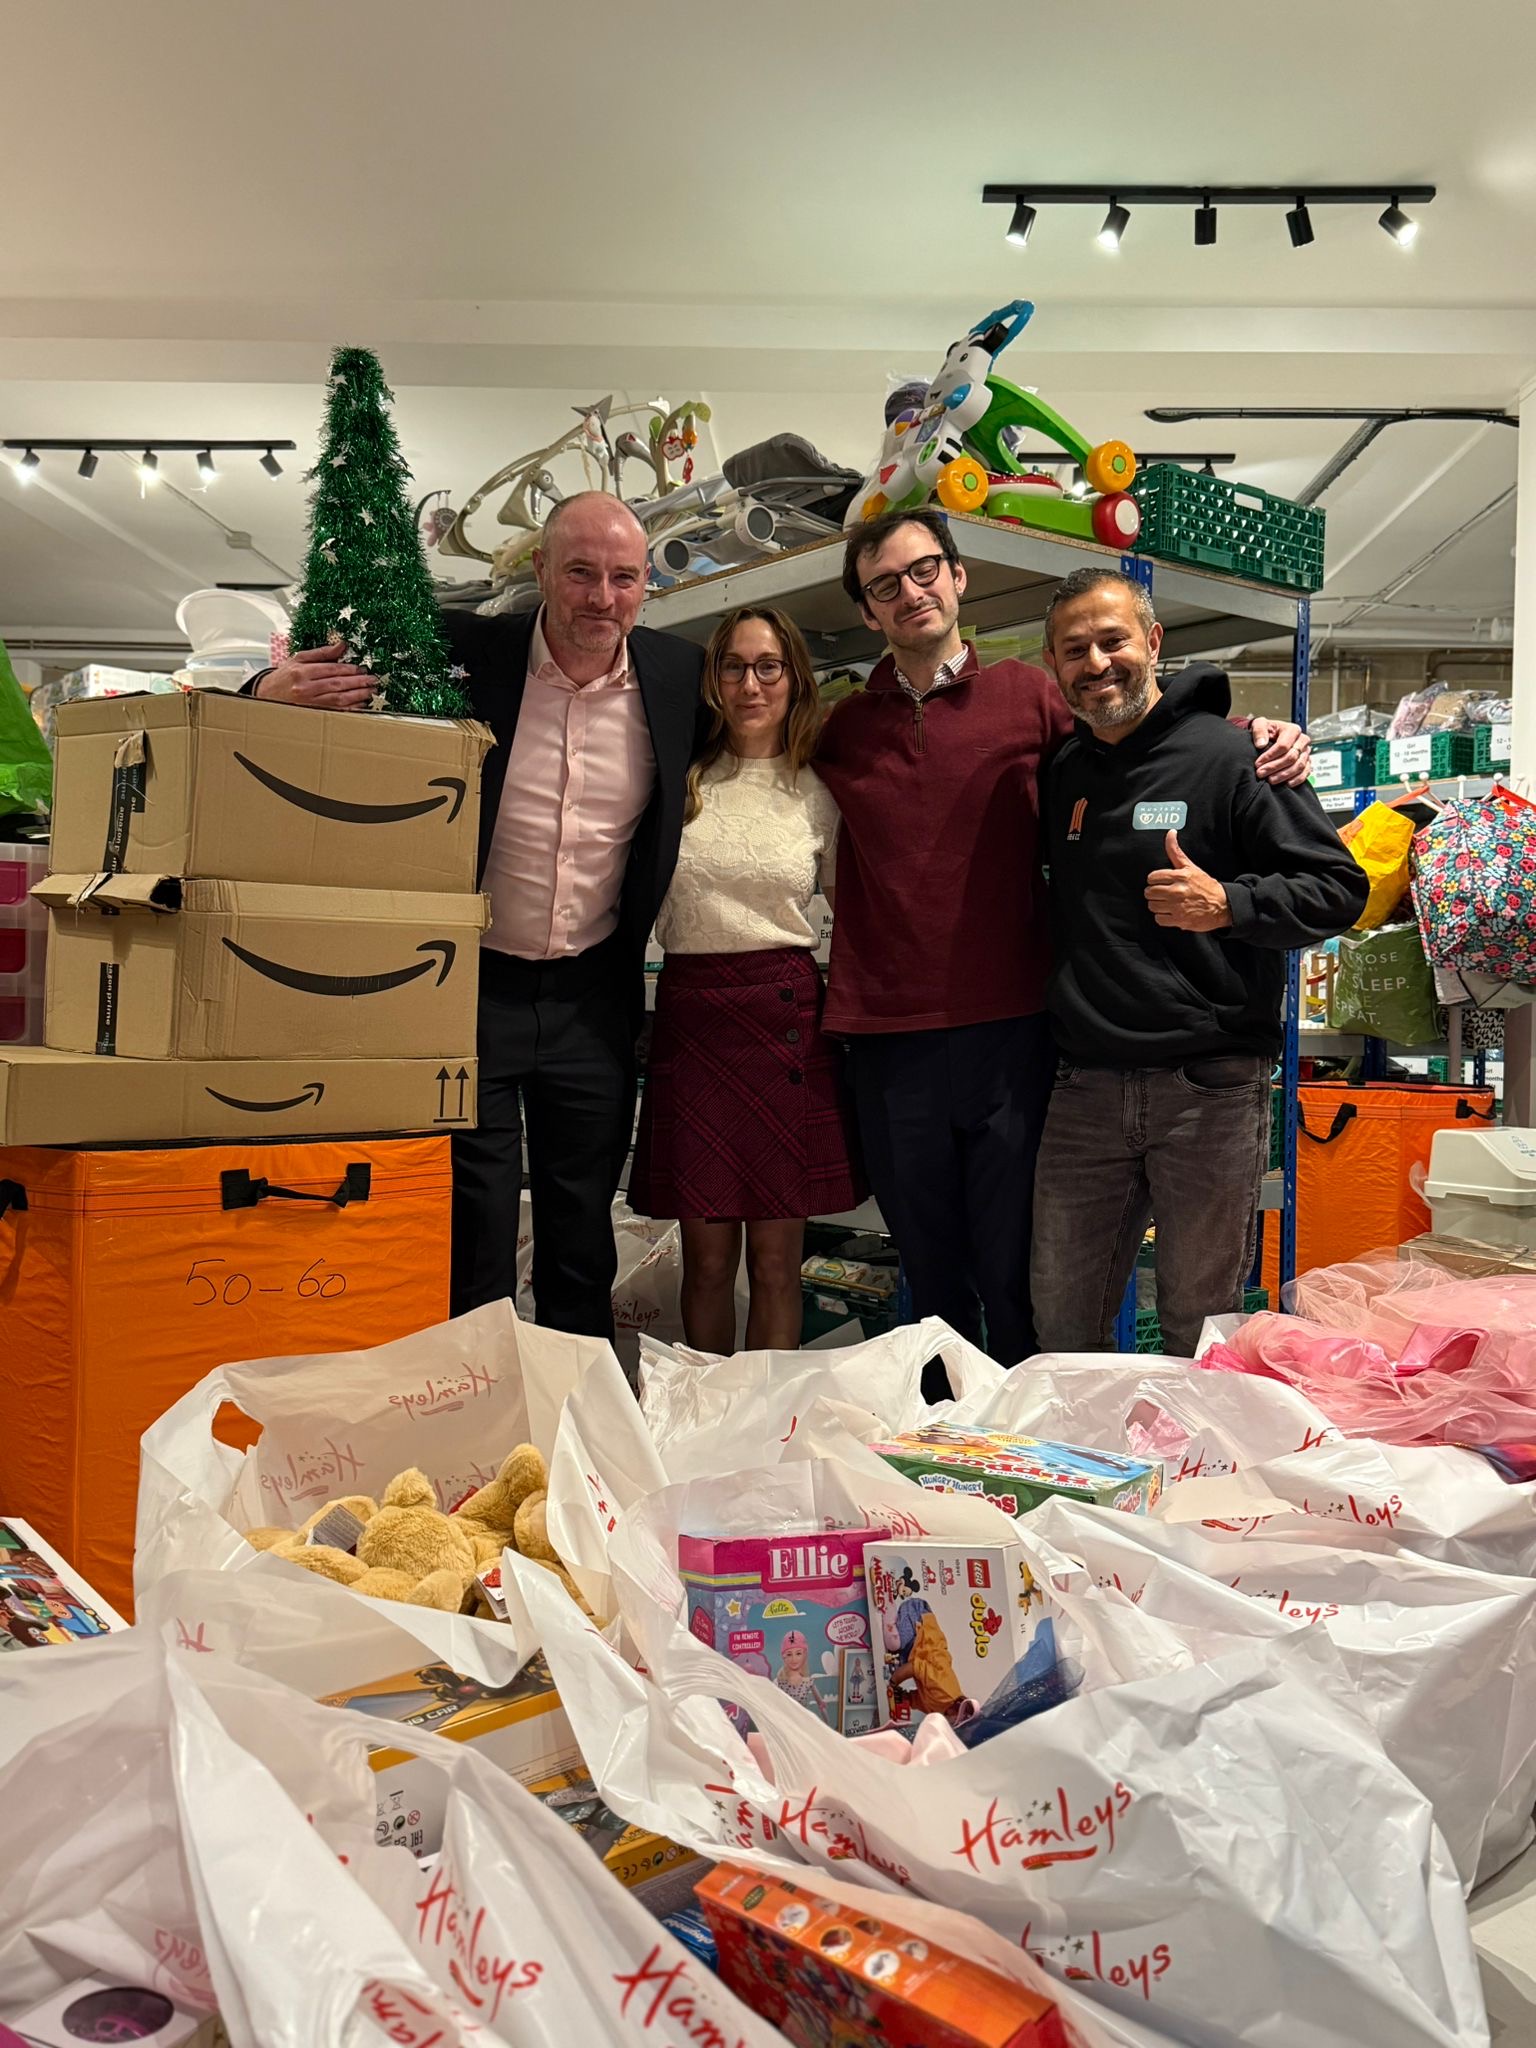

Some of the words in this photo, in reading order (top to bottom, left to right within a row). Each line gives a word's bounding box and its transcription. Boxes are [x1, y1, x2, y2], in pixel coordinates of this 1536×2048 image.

[116, 806, 125, 842] amazon
[1155, 813, 1180, 824] AID
[1352, 976, 1410, 992] SLEEP.
[104, 993, 113, 1026] prime
[1335, 995, 1381, 1025] EPEAT.
[611, 1300, 661, 1331] amleys
[920, 1475, 951, 1486] HUNGRY
[951, 1480, 981, 1492] HUNGRY
[769, 1545, 849, 1582] Ellie
[873, 1556, 886, 1615] MICKEY
[769, 1601, 790, 1614] hello
[969, 1592, 989, 1658] duplo
[427, 1704, 459, 1721] CAR
[950, 1781, 1132, 1874] Hamleys
